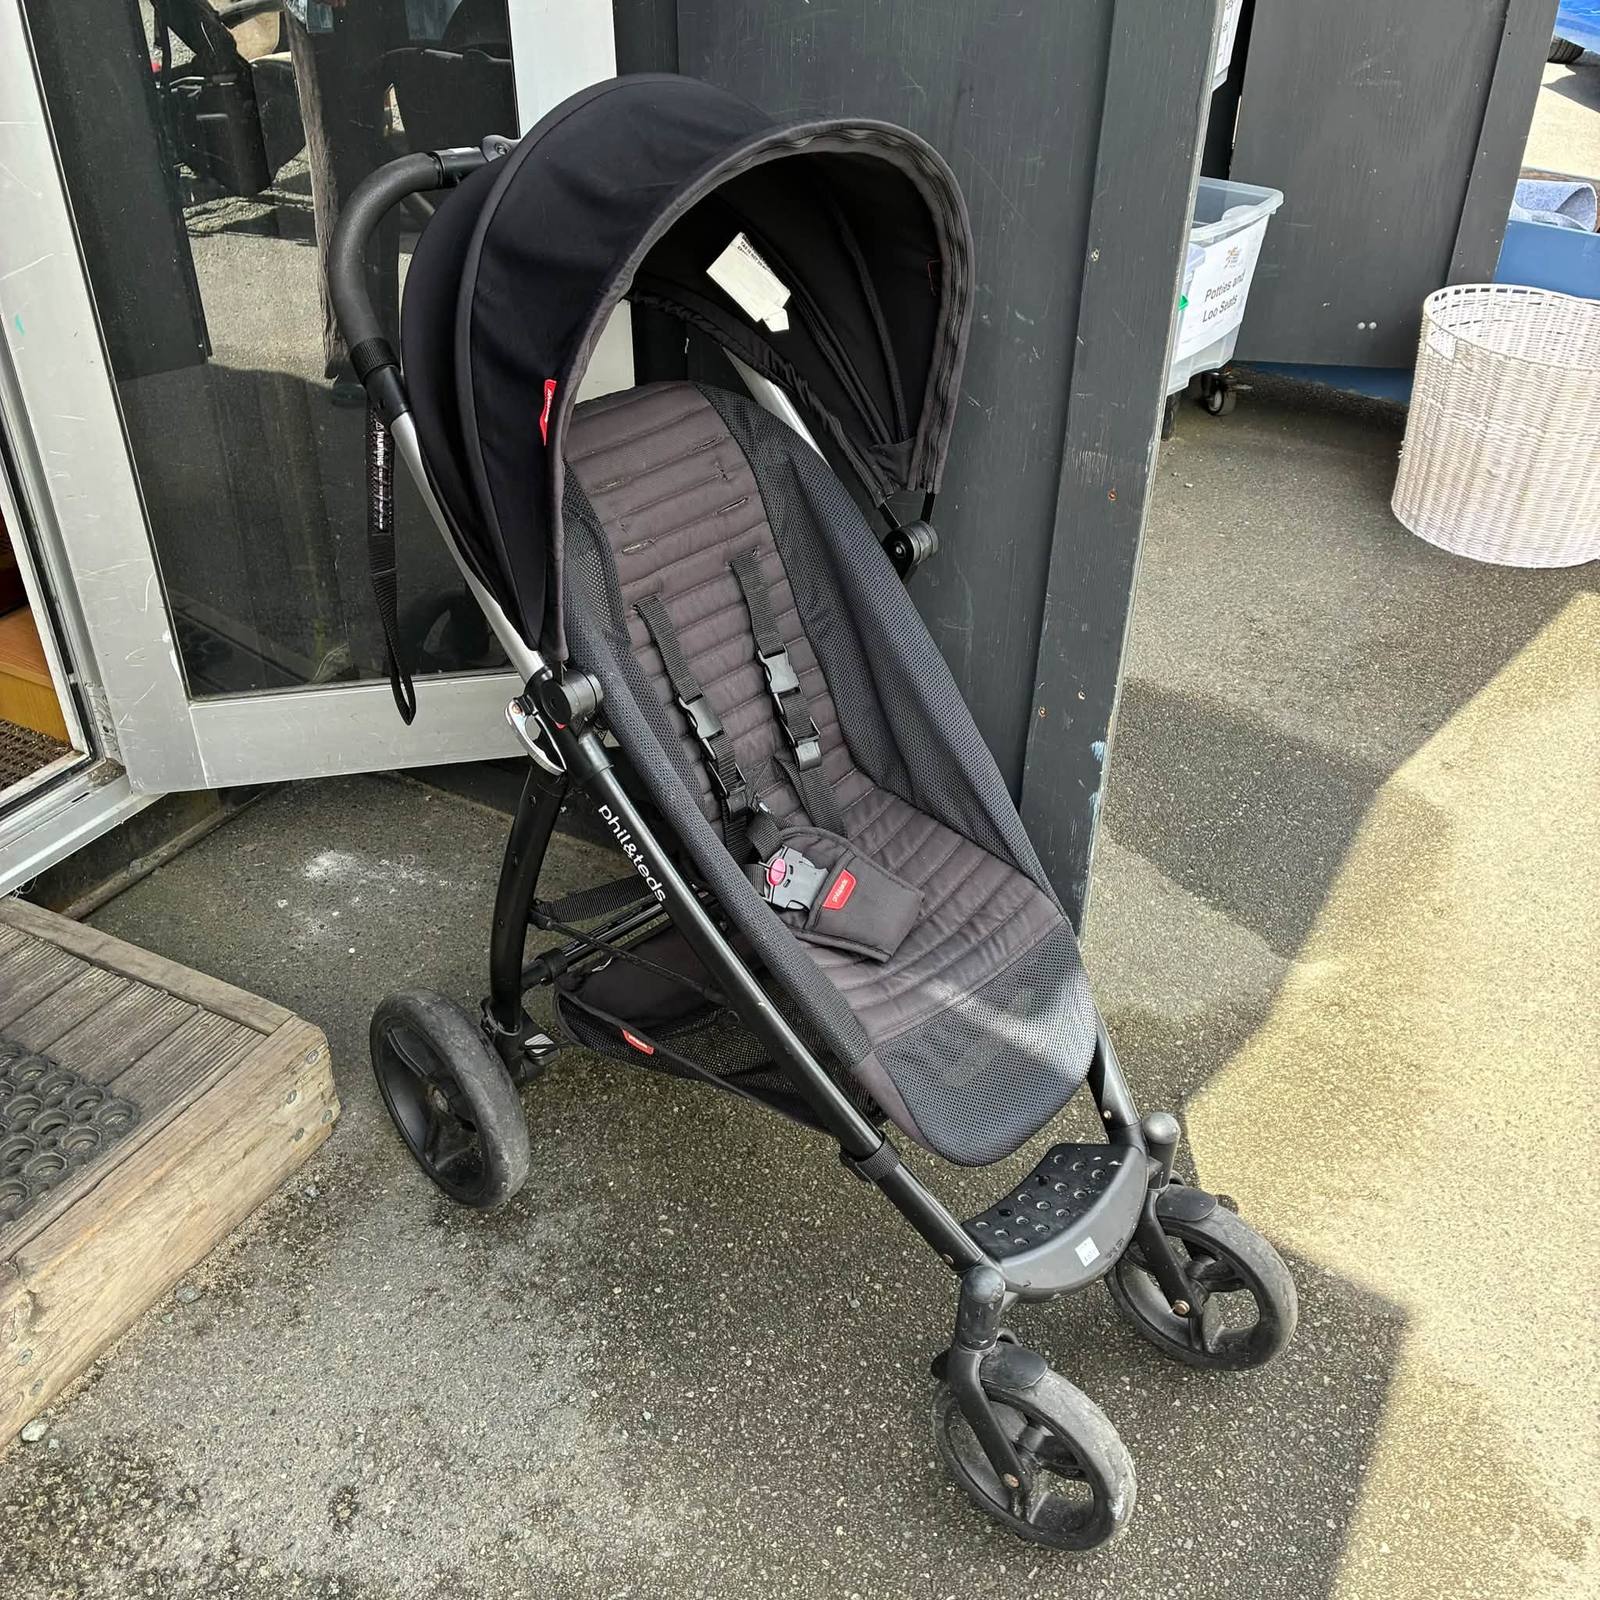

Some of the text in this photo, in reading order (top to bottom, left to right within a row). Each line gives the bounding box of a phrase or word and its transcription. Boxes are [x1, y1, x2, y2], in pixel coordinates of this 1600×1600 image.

[1204, 268, 1246, 302] Potties and
[1202, 307, 1218, 323] Loo
[376, 431, 385, 466] WARNING
[598, 804, 666, 902] phil&teds
